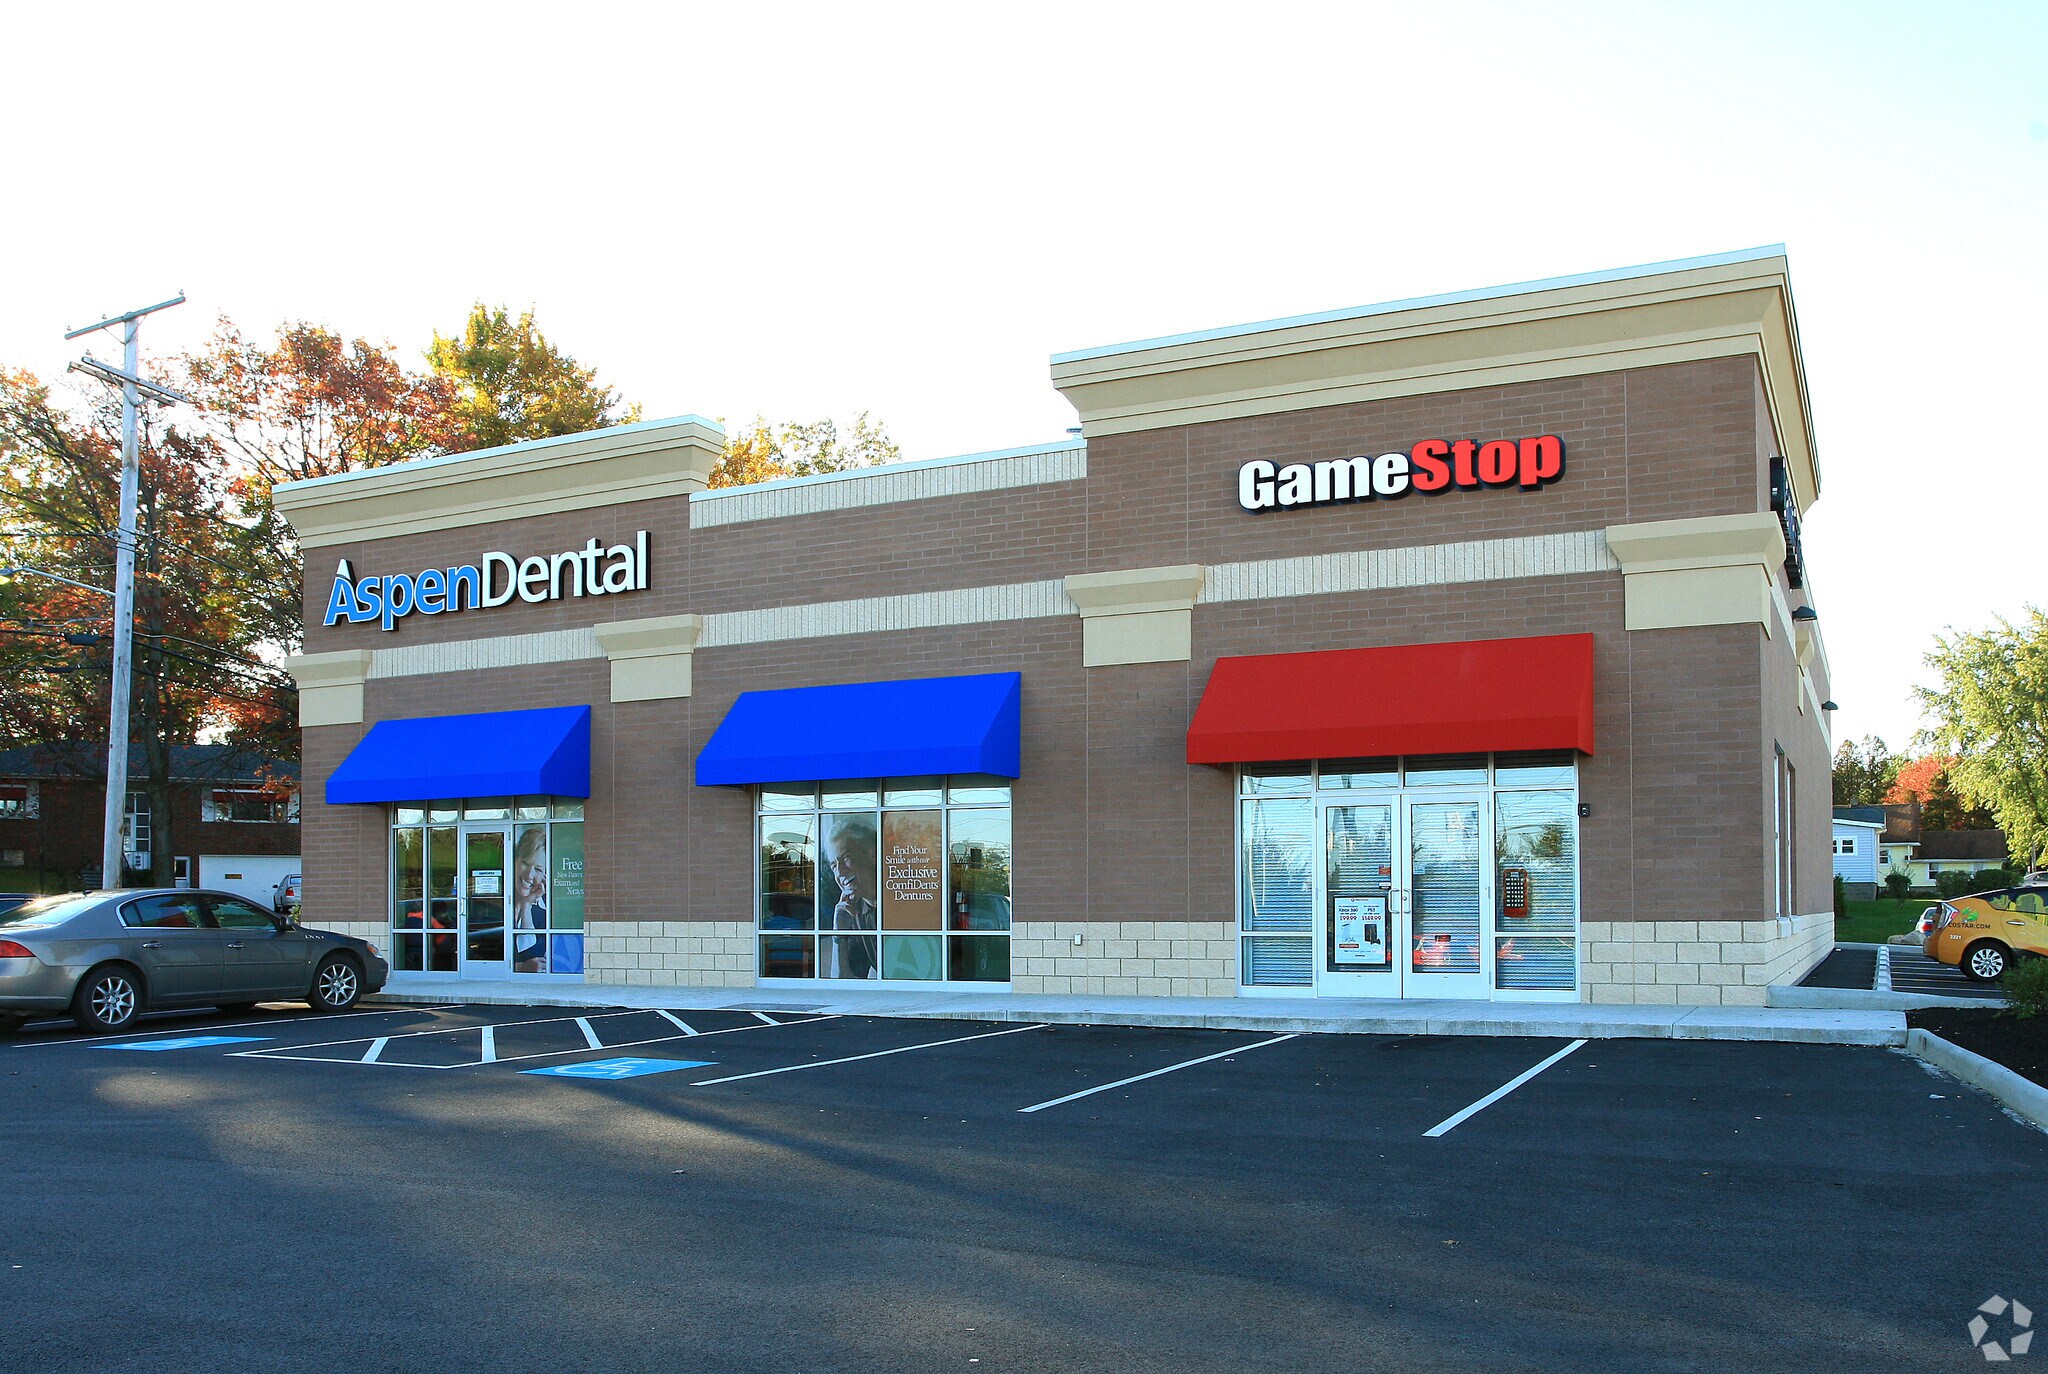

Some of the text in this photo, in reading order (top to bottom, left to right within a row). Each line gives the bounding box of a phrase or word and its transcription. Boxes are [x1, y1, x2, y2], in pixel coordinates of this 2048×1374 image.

[1238, 434, 1563, 510] GameStop
[322, 529, 648, 631] AspenDental
[893, 845, 928, 855] Find Your
[562, 857, 583, 871] Free
[885, 855, 906, 864] Smile
[888, 864, 938, 879] Exclusive
[553, 878, 571, 887] Exam
[894, 890, 934, 901] Dentures
